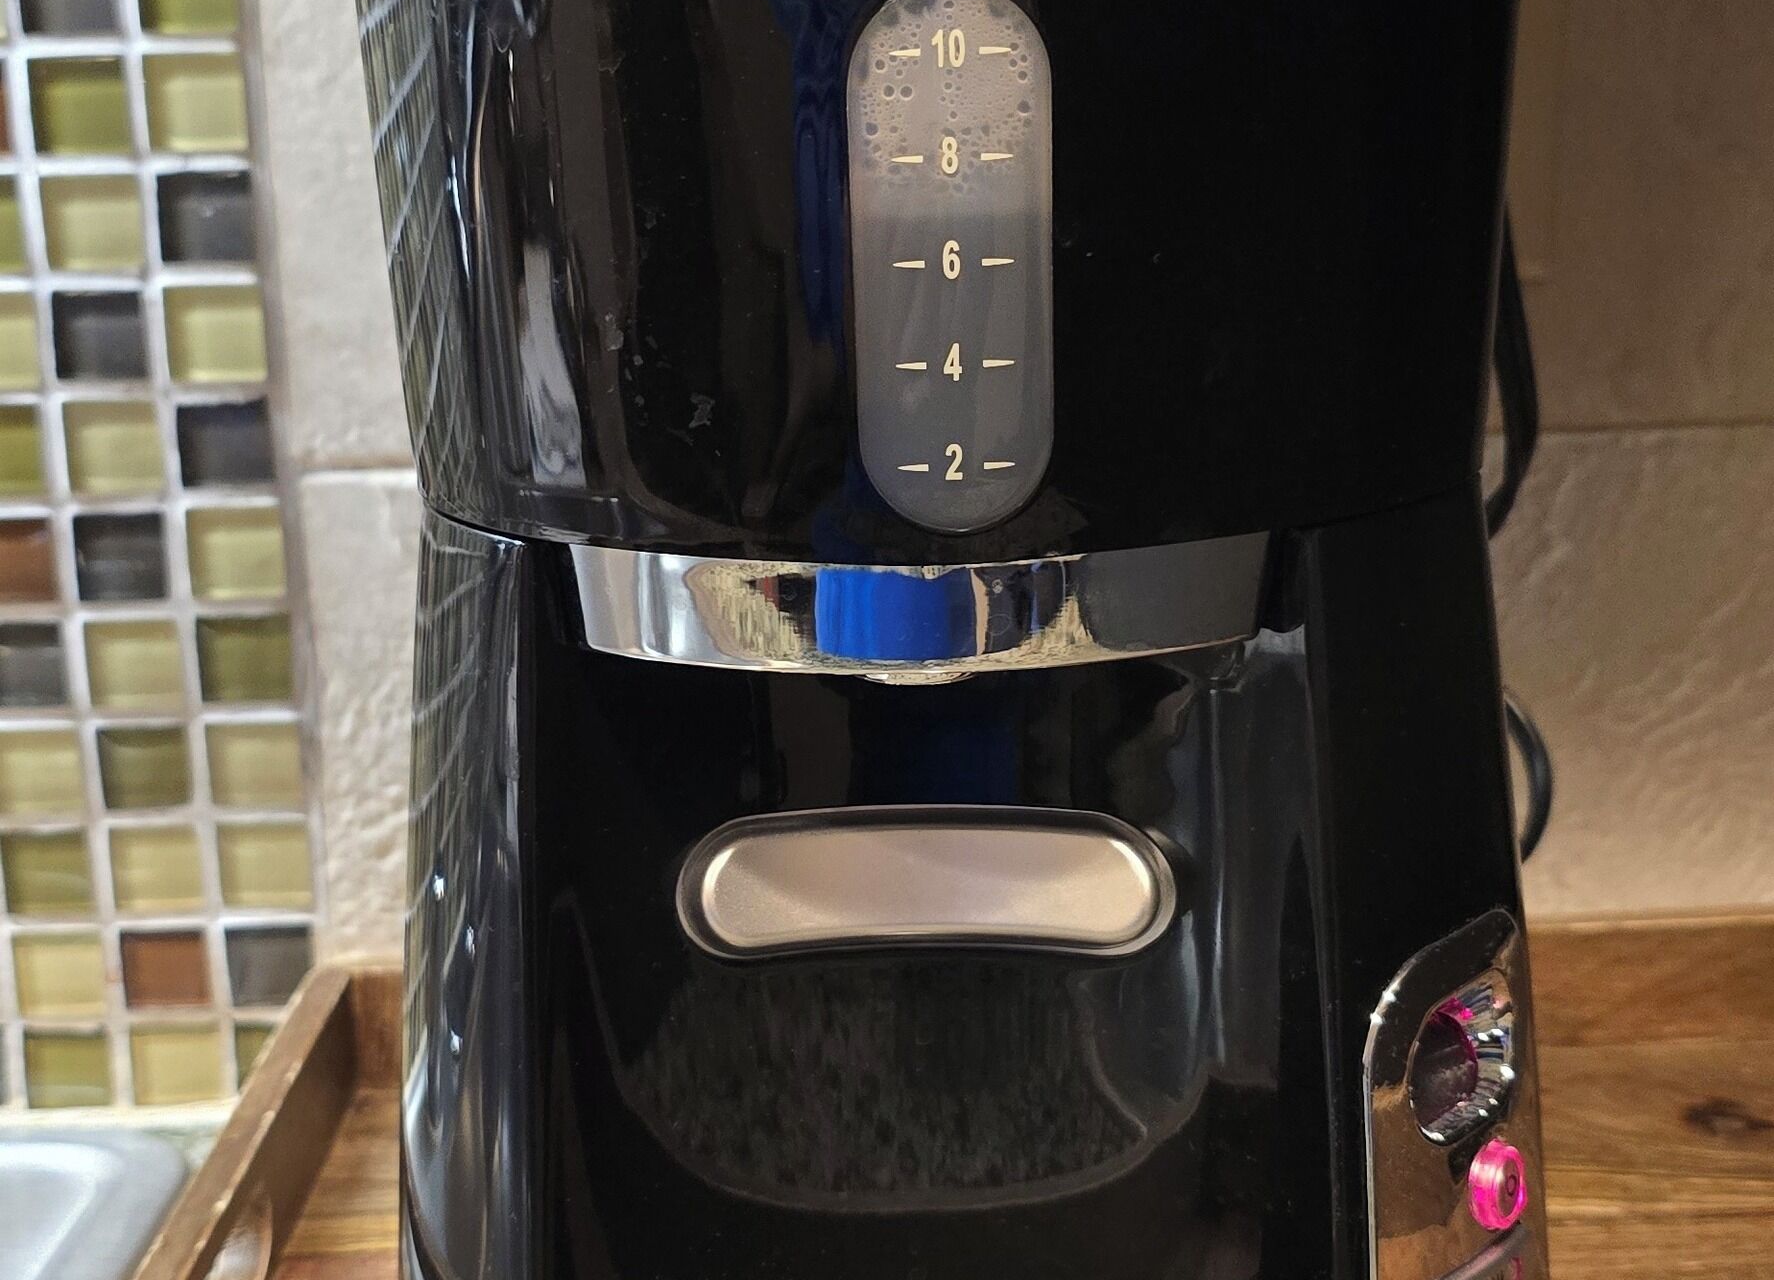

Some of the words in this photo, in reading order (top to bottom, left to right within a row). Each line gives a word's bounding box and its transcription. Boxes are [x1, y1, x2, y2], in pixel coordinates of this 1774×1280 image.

[931, 28, 966, 68] 10
[941, 136, 959, 174] 8
[942, 240, 961, 280] 6
[943, 343, 963, 382] 4
[945, 443, 964, 481] 2
